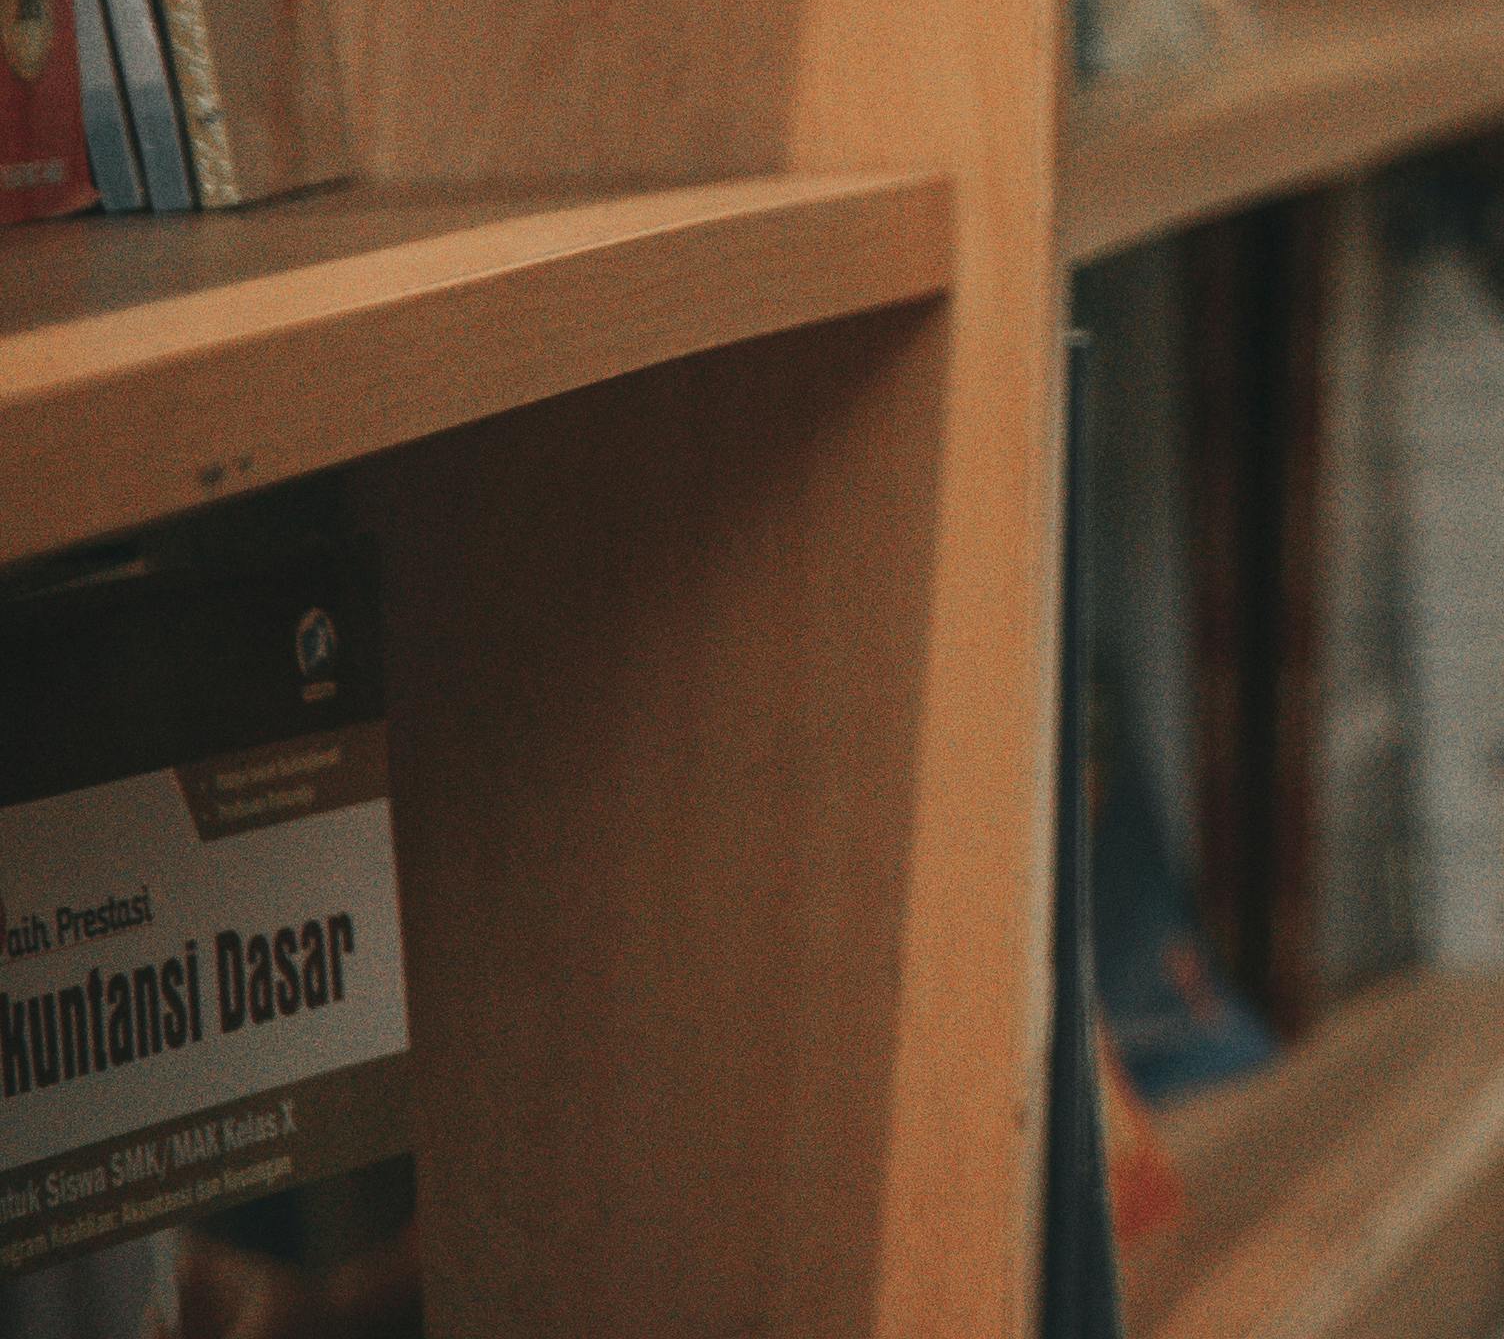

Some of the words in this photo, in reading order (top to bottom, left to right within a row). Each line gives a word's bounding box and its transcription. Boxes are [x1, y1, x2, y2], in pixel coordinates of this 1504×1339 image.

[0, 903, 51, 958] aih
[56, 885, 152, 945] Prestasi
[216, 912, 355, 1034] Dasar
[45, 1165, 107, 1207] Siswa
